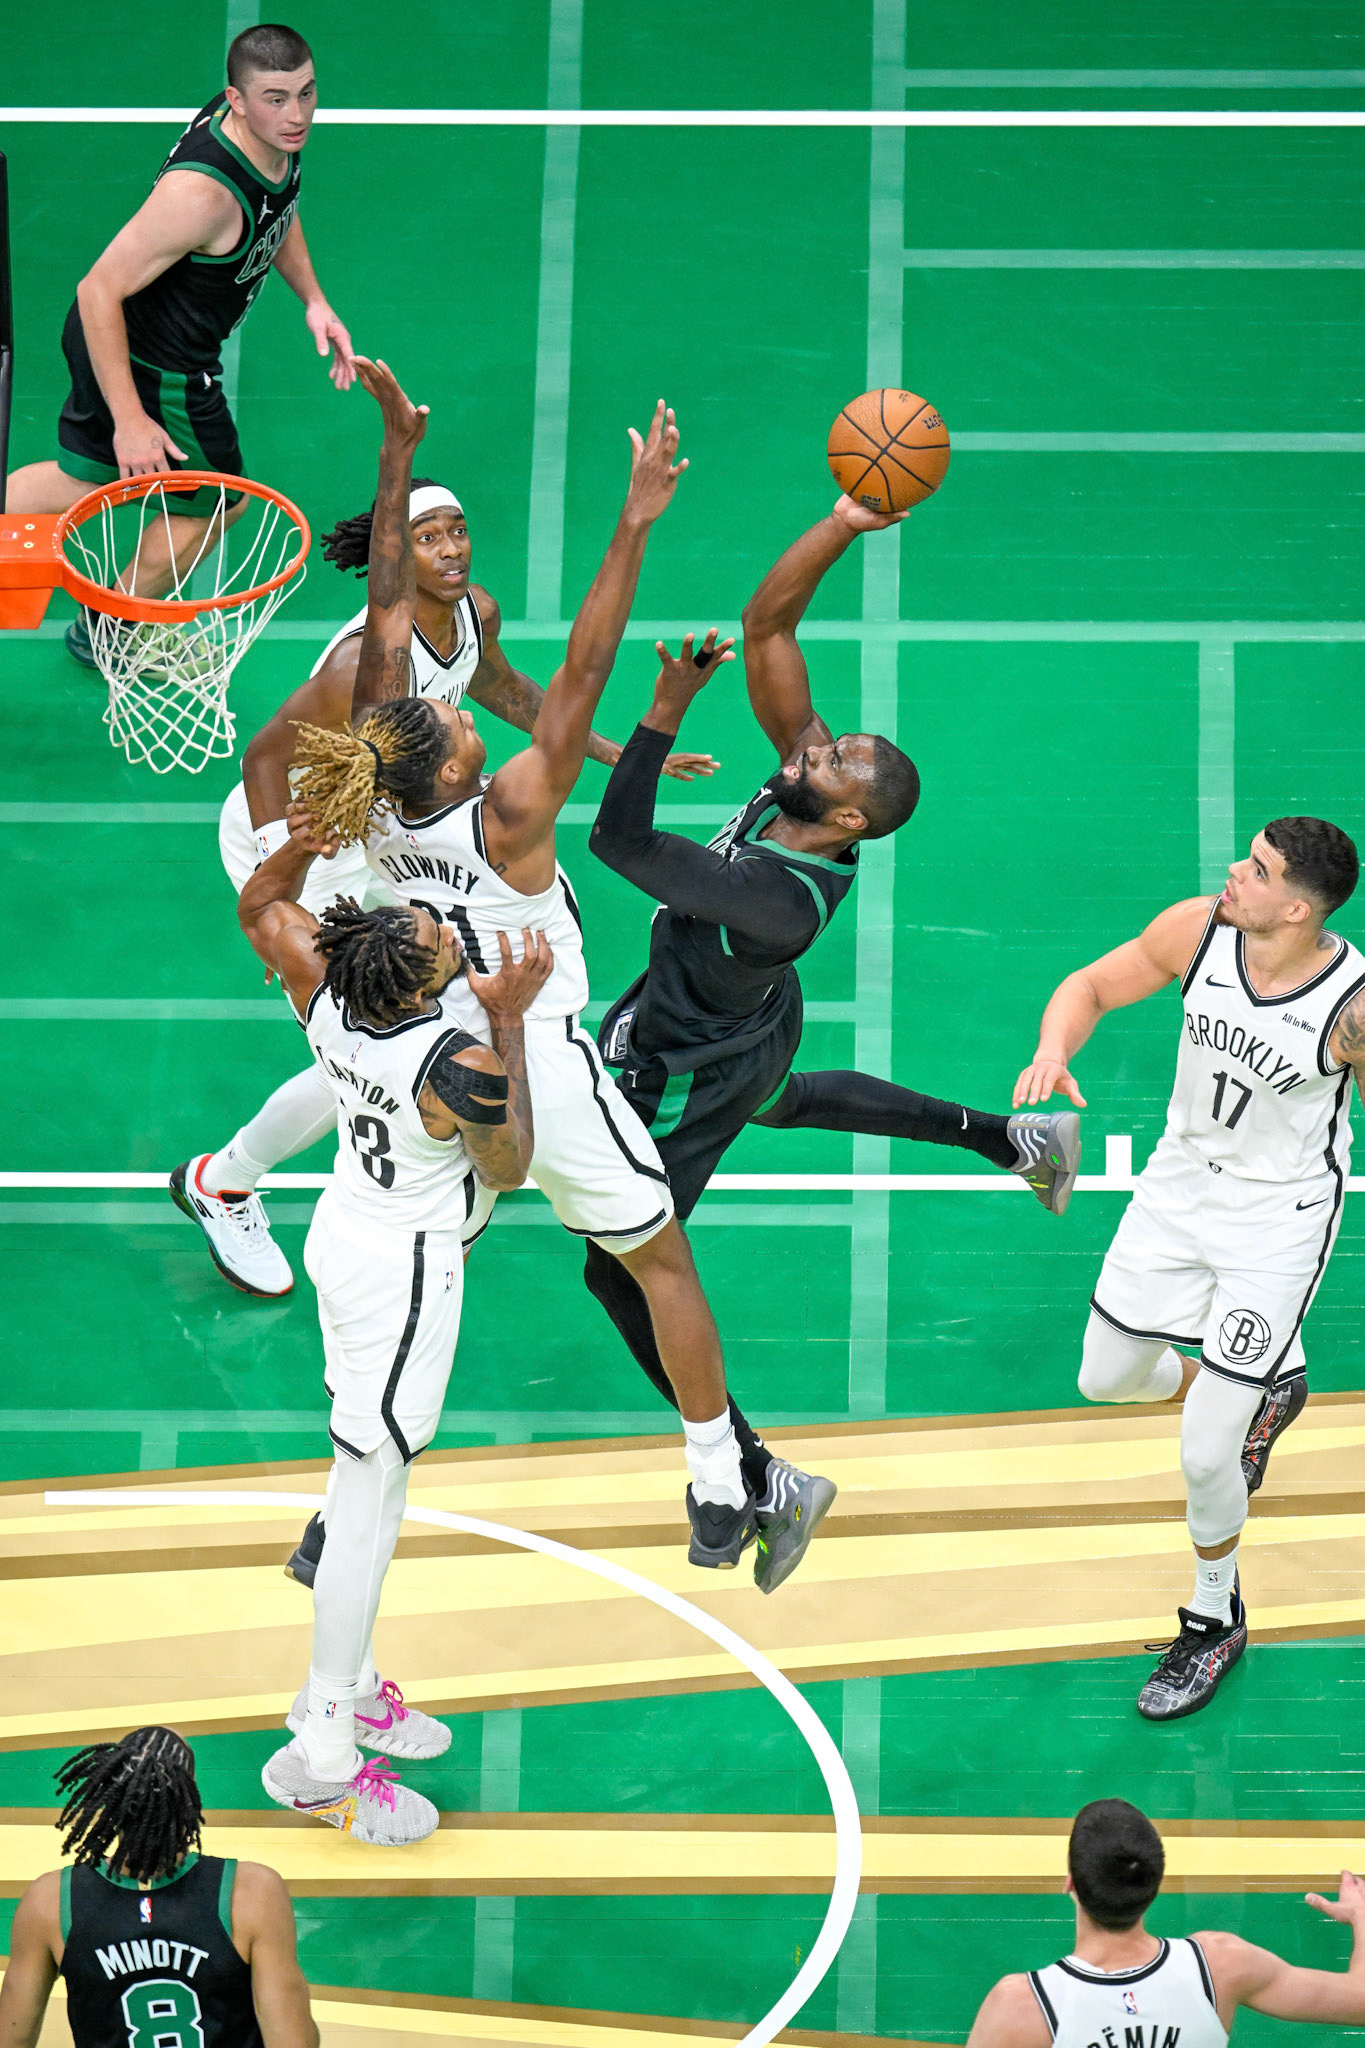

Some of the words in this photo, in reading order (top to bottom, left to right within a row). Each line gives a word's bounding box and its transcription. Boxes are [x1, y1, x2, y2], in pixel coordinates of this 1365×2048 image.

[379, 853, 480, 895] CLOWNEY
[1186, 1012, 1307, 1095] BROOKLYN
[1211, 1070, 1253, 1130] 17
[1229, 1316, 1256, 1356] B
[1186, 1620, 1207, 1632] ROAR
[94, 1938, 210, 1981] MINOTT
[120, 1978, 205, 2048] 8
[1087, 2024, 1181, 2048] ËMIN
